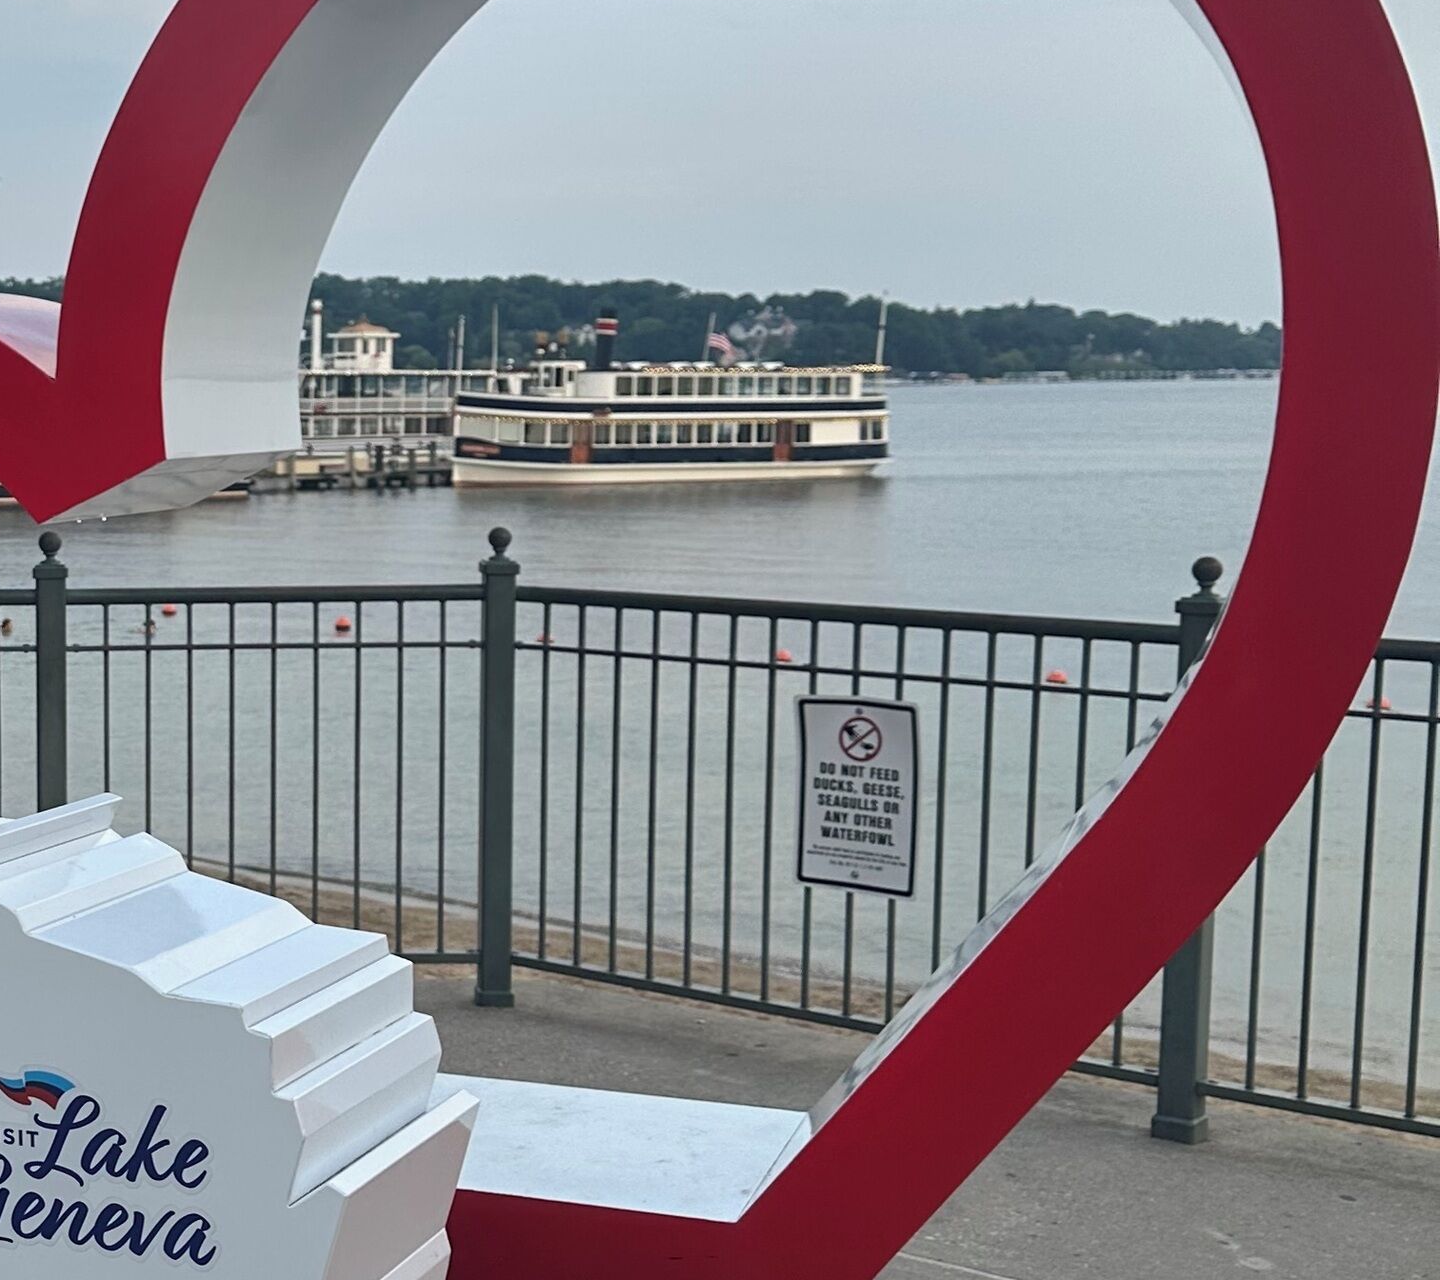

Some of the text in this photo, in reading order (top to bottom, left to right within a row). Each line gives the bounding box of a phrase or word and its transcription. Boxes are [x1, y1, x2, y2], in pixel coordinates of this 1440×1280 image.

[820, 762, 899, 781] DO NOT FEED
[863, 783, 905, 800] GEESE,
[818, 793, 899, 815] SEAGULLS OR
[824, 810, 892, 830] ANY OTHER
[821, 826, 895, 847] WATERFOWL
[24, 1095, 209, 1188] Lake
